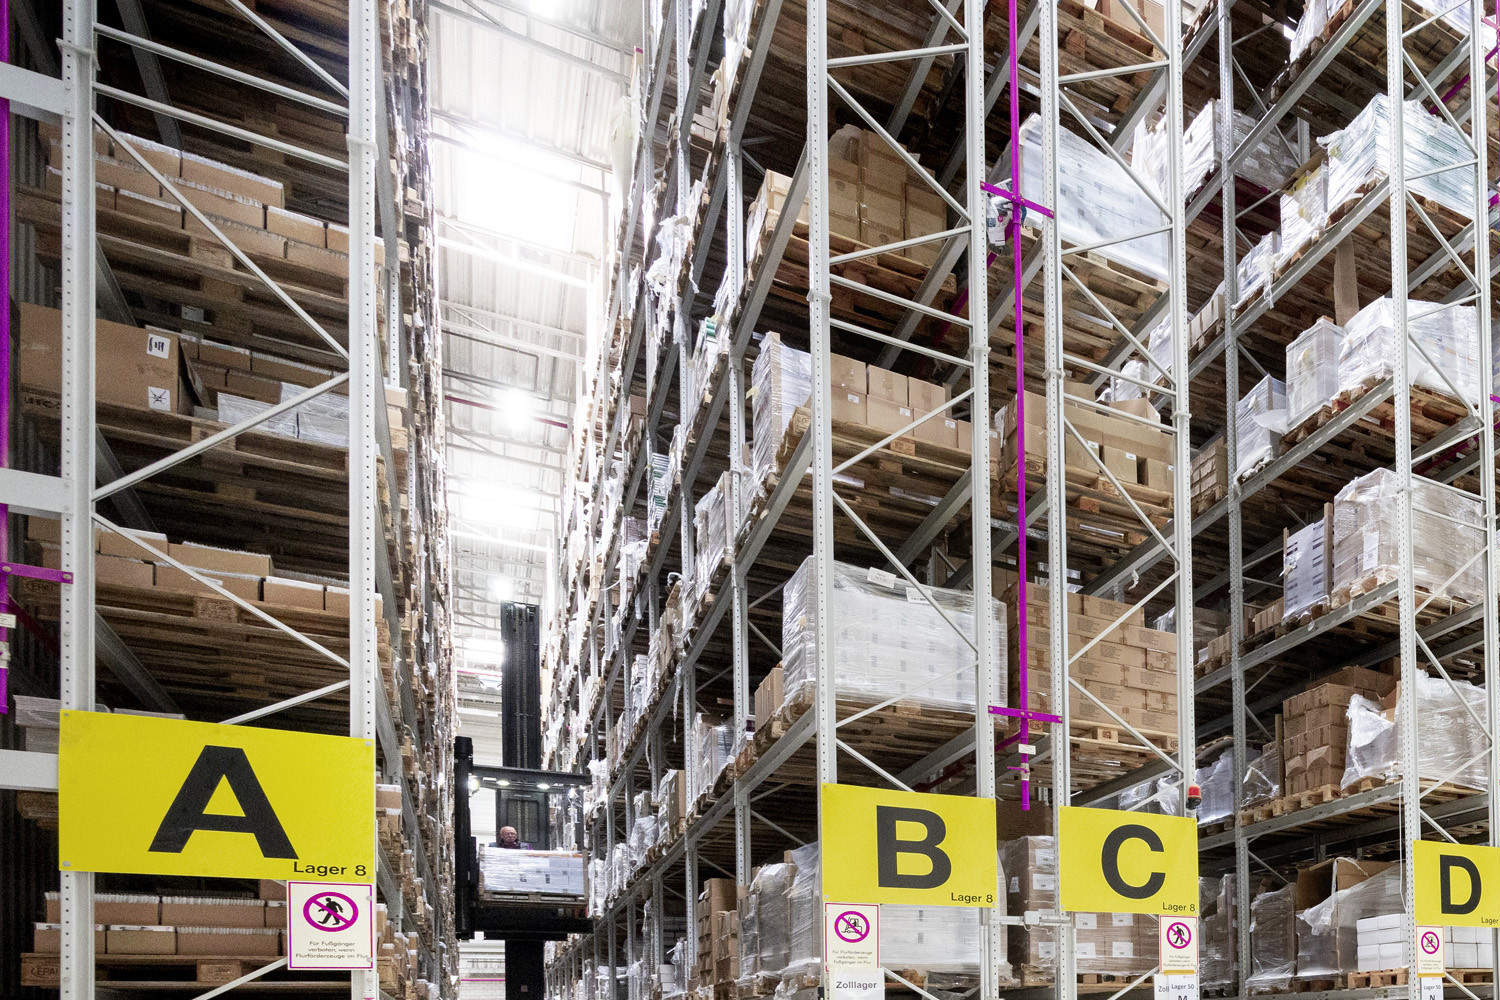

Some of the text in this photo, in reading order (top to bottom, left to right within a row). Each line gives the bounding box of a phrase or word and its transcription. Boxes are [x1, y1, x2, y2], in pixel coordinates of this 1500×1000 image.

[148, 745, 299, 859] A
[876, 805, 952, 889] B
[294, 861, 367, 876] Lager 8
[1101, 824, 1166, 899] C
[1439, 854, 1482, 915] D
[951, 892, 993, 903] Lager 8
[1162, 902, 1195, 912] Lager 8
[1481, 917, 1499, 925] Lager
[836, 981, 877, 990] Zolllager
